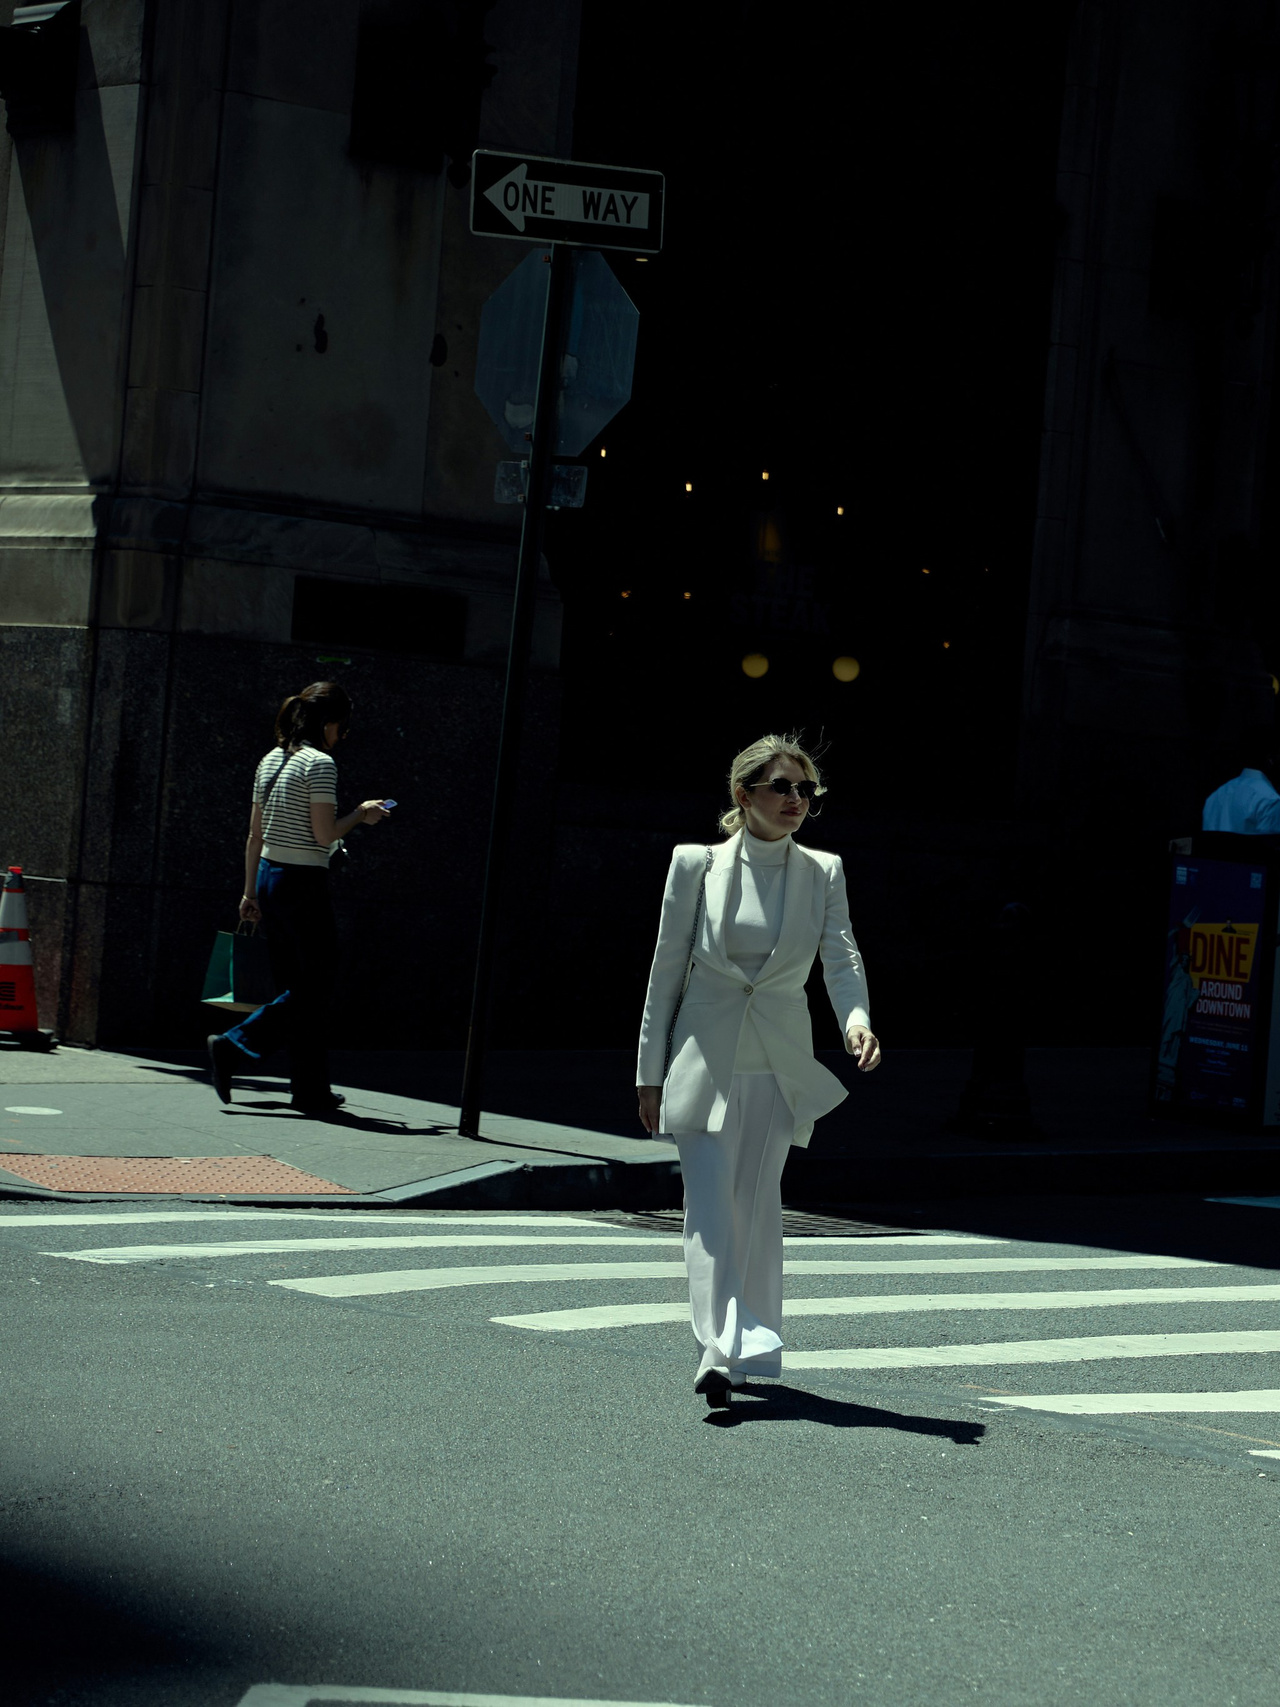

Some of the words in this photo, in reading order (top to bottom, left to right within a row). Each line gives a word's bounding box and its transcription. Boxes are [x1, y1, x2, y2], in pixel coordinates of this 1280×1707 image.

[503, 181, 555, 216] ONE
[582, 190, 639, 224] WAY
[728, 590, 832, 636] STEAK
[1191, 931, 1250, 980] DINE
[1195, 999, 1251, 1019] DOWNTOWN
[1200, 981, 1243, 1001] AROUND
